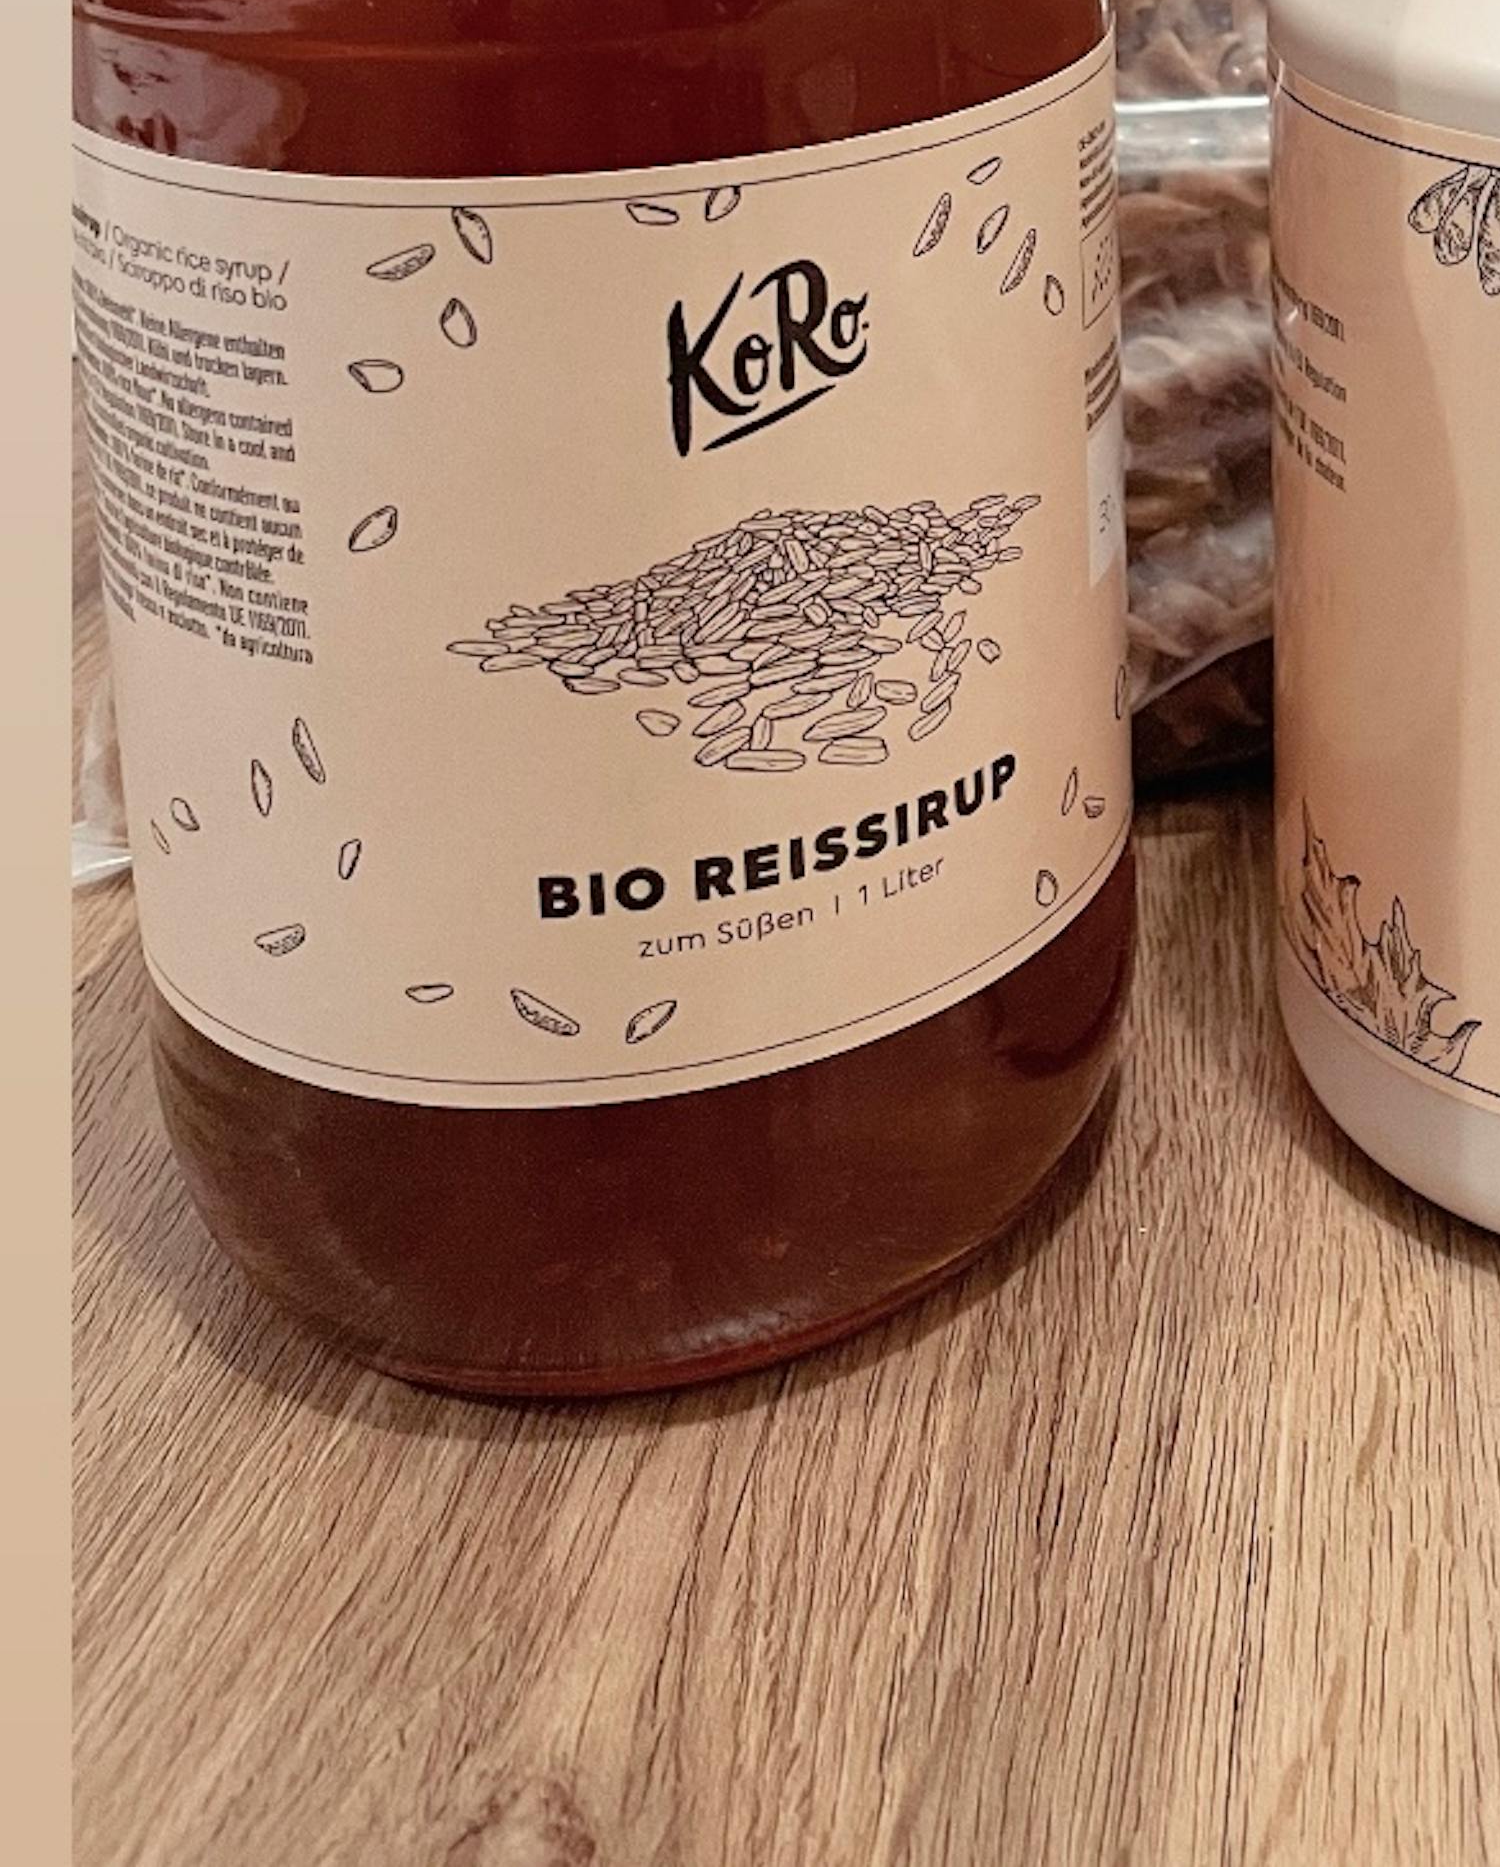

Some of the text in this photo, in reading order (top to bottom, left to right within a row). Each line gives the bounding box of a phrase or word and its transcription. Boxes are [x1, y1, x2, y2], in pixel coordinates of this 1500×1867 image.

[112, 225, 173, 262] Organic
[176, 246, 210, 272] rice
[215, 258, 272, 284] syrup
[189, 277, 206, 299] di
[212, 281, 246, 306] riso
[252, 287, 287, 312] bio
[223, 334, 286, 361] enthalten
[194, 351, 240, 378] trocken
[177, 397, 226, 427] allergens
[229, 413, 292, 437] contained
[269, 443, 295, 463] and
[209, 507, 258, 532] contient
[233, 536, 285, 563] protéger
[248, 588, 308, 616] contiene
[239, 634, 313, 666] agricoltura
[538, 753, 1018, 920] BIO REISSIRUP
[638, 929, 707, 959] zum
[716, 902, 816, 946] Süßen
[857, 883, 869, 907] 1
[881, 854, 946, 900] Liter
